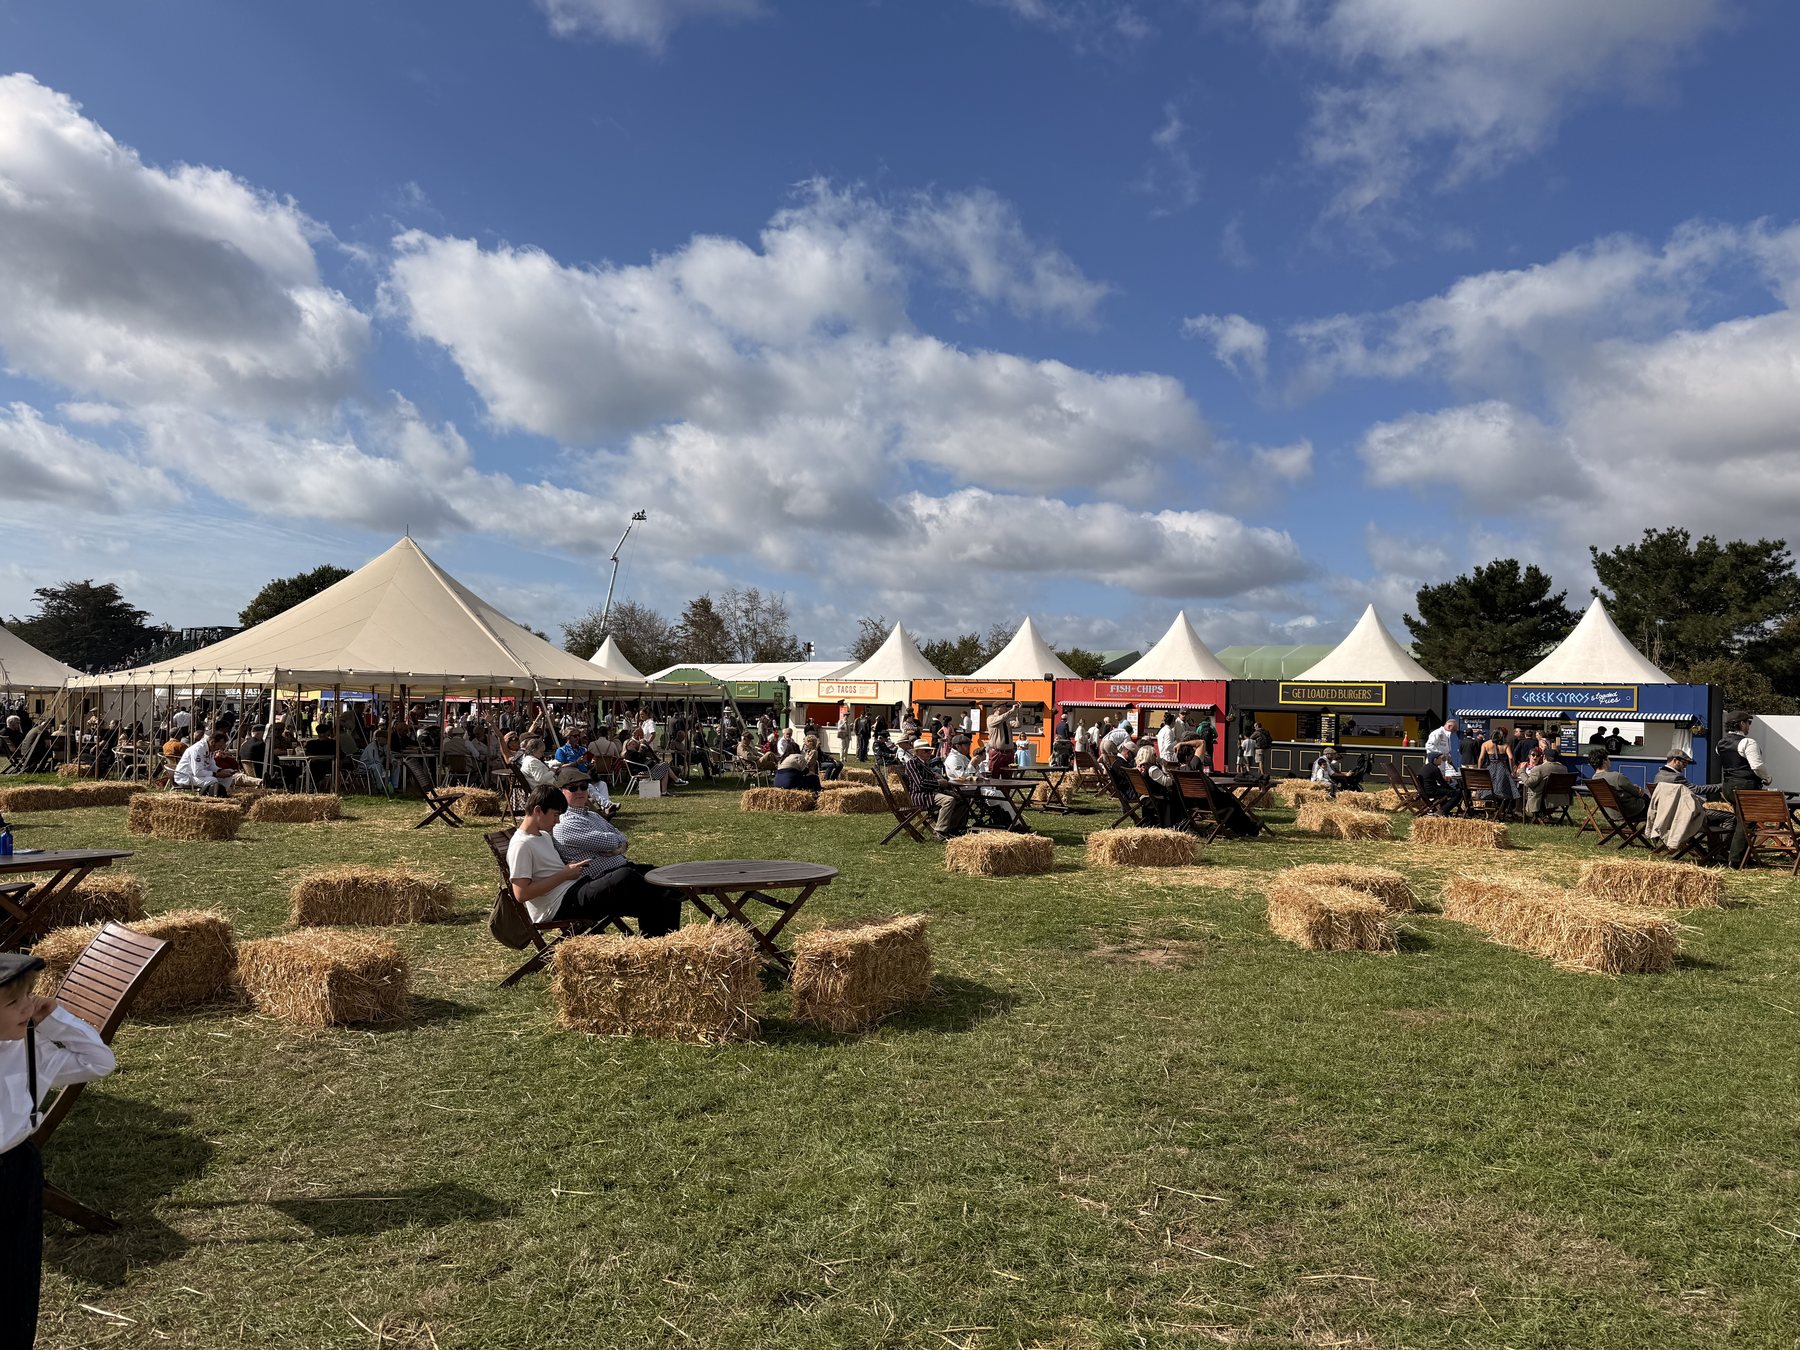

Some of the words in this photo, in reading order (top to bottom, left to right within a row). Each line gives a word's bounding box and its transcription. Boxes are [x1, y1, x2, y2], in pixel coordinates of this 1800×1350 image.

[837, 686, 857, 694] TACOS
[962, 686, 987, 694] CHICKEN
[1110, 684, 1131, 692] FISH
[1136, 685, 1164, 694] CHIPS
[1292, 688, 1305, 698] GET
[1307, 688, 1337, 699] LOADED
[1338, 689, 1372, 700] BURGERS
[1522, 692, 1554, 702] GREEK
[1556, 692, 1590, 703] GYROS
